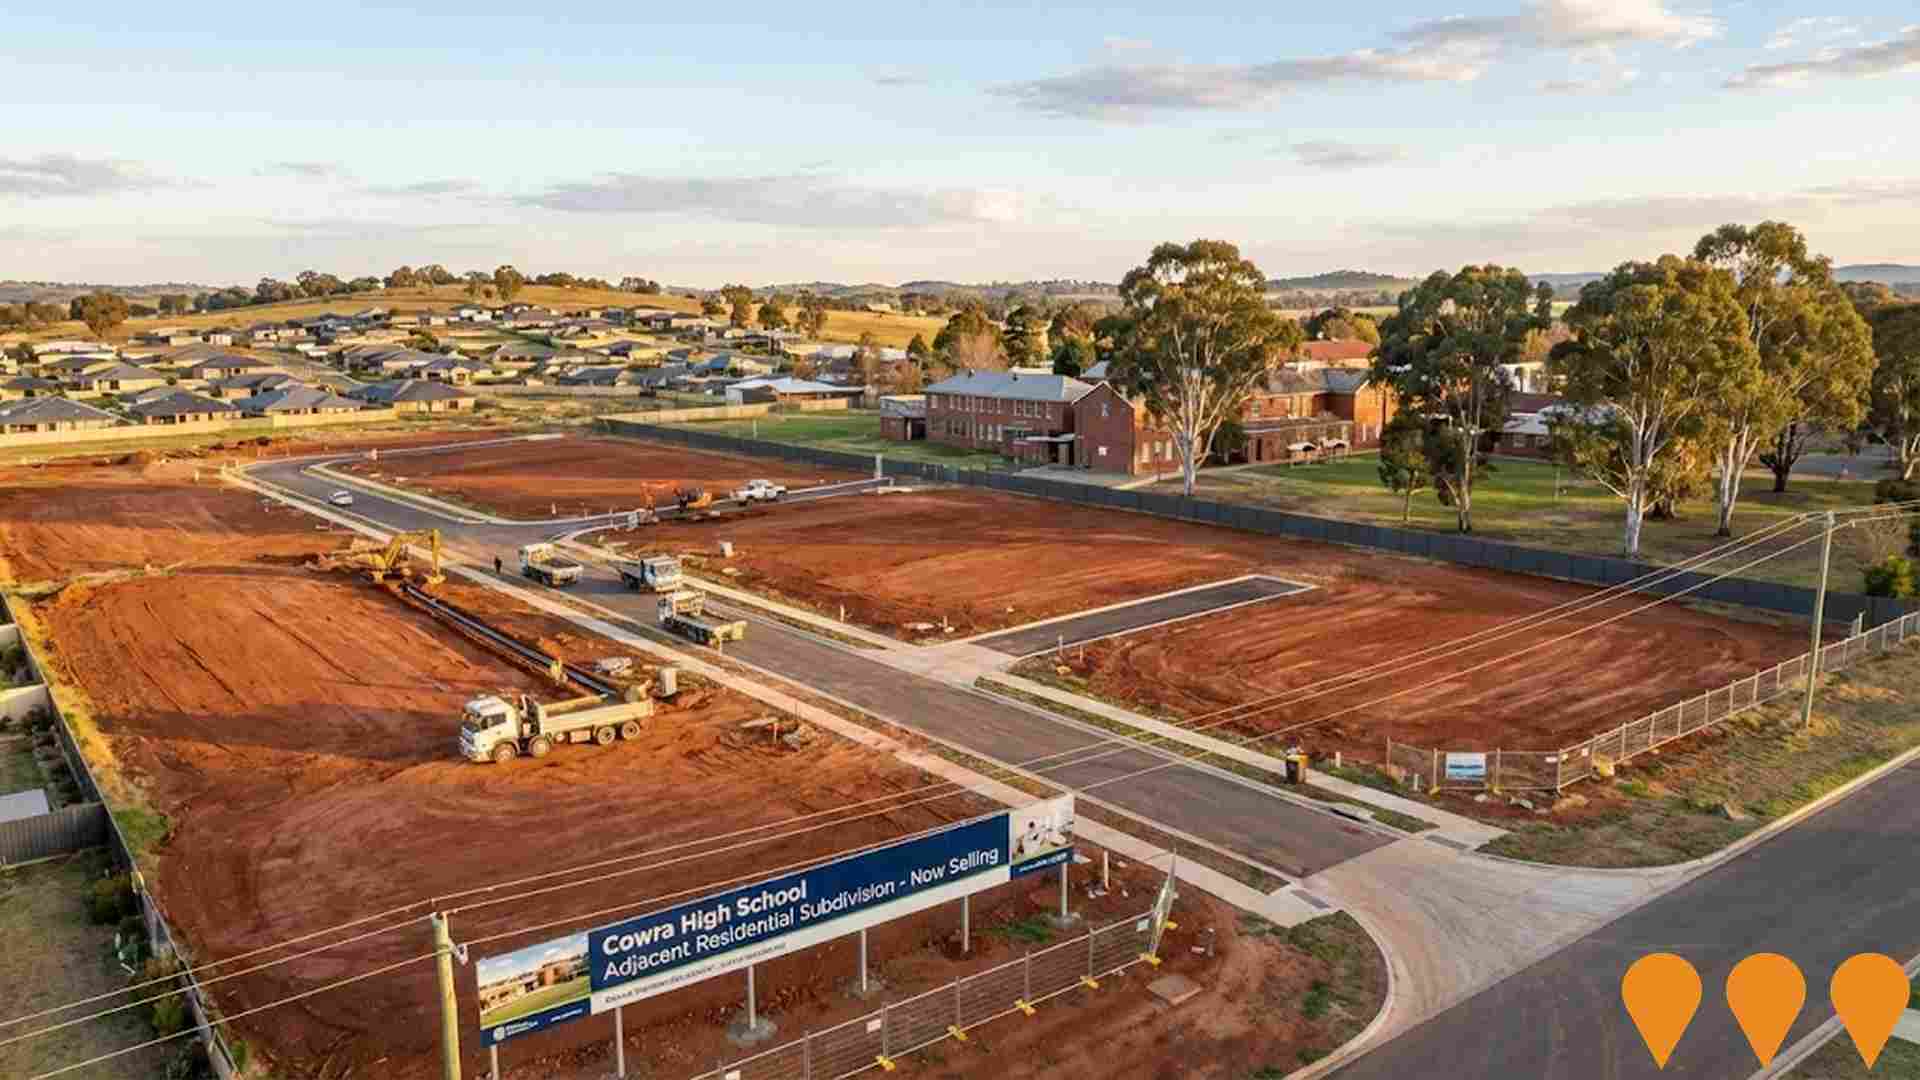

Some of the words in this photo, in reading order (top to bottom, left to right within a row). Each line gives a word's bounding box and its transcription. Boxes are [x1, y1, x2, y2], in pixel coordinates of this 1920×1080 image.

[602, 922, 676, 957] Cowra
[681, 903, 731, 936] High
[736, 879, 808, 918] School
[603, 942, 693, 982] Adjacent
[696, 906, 795, 954] Residential
[799, 881, 895, 922] Subdivision
[910, 864, 947, 888] Now
[949, 847, 999, 876] Selling
